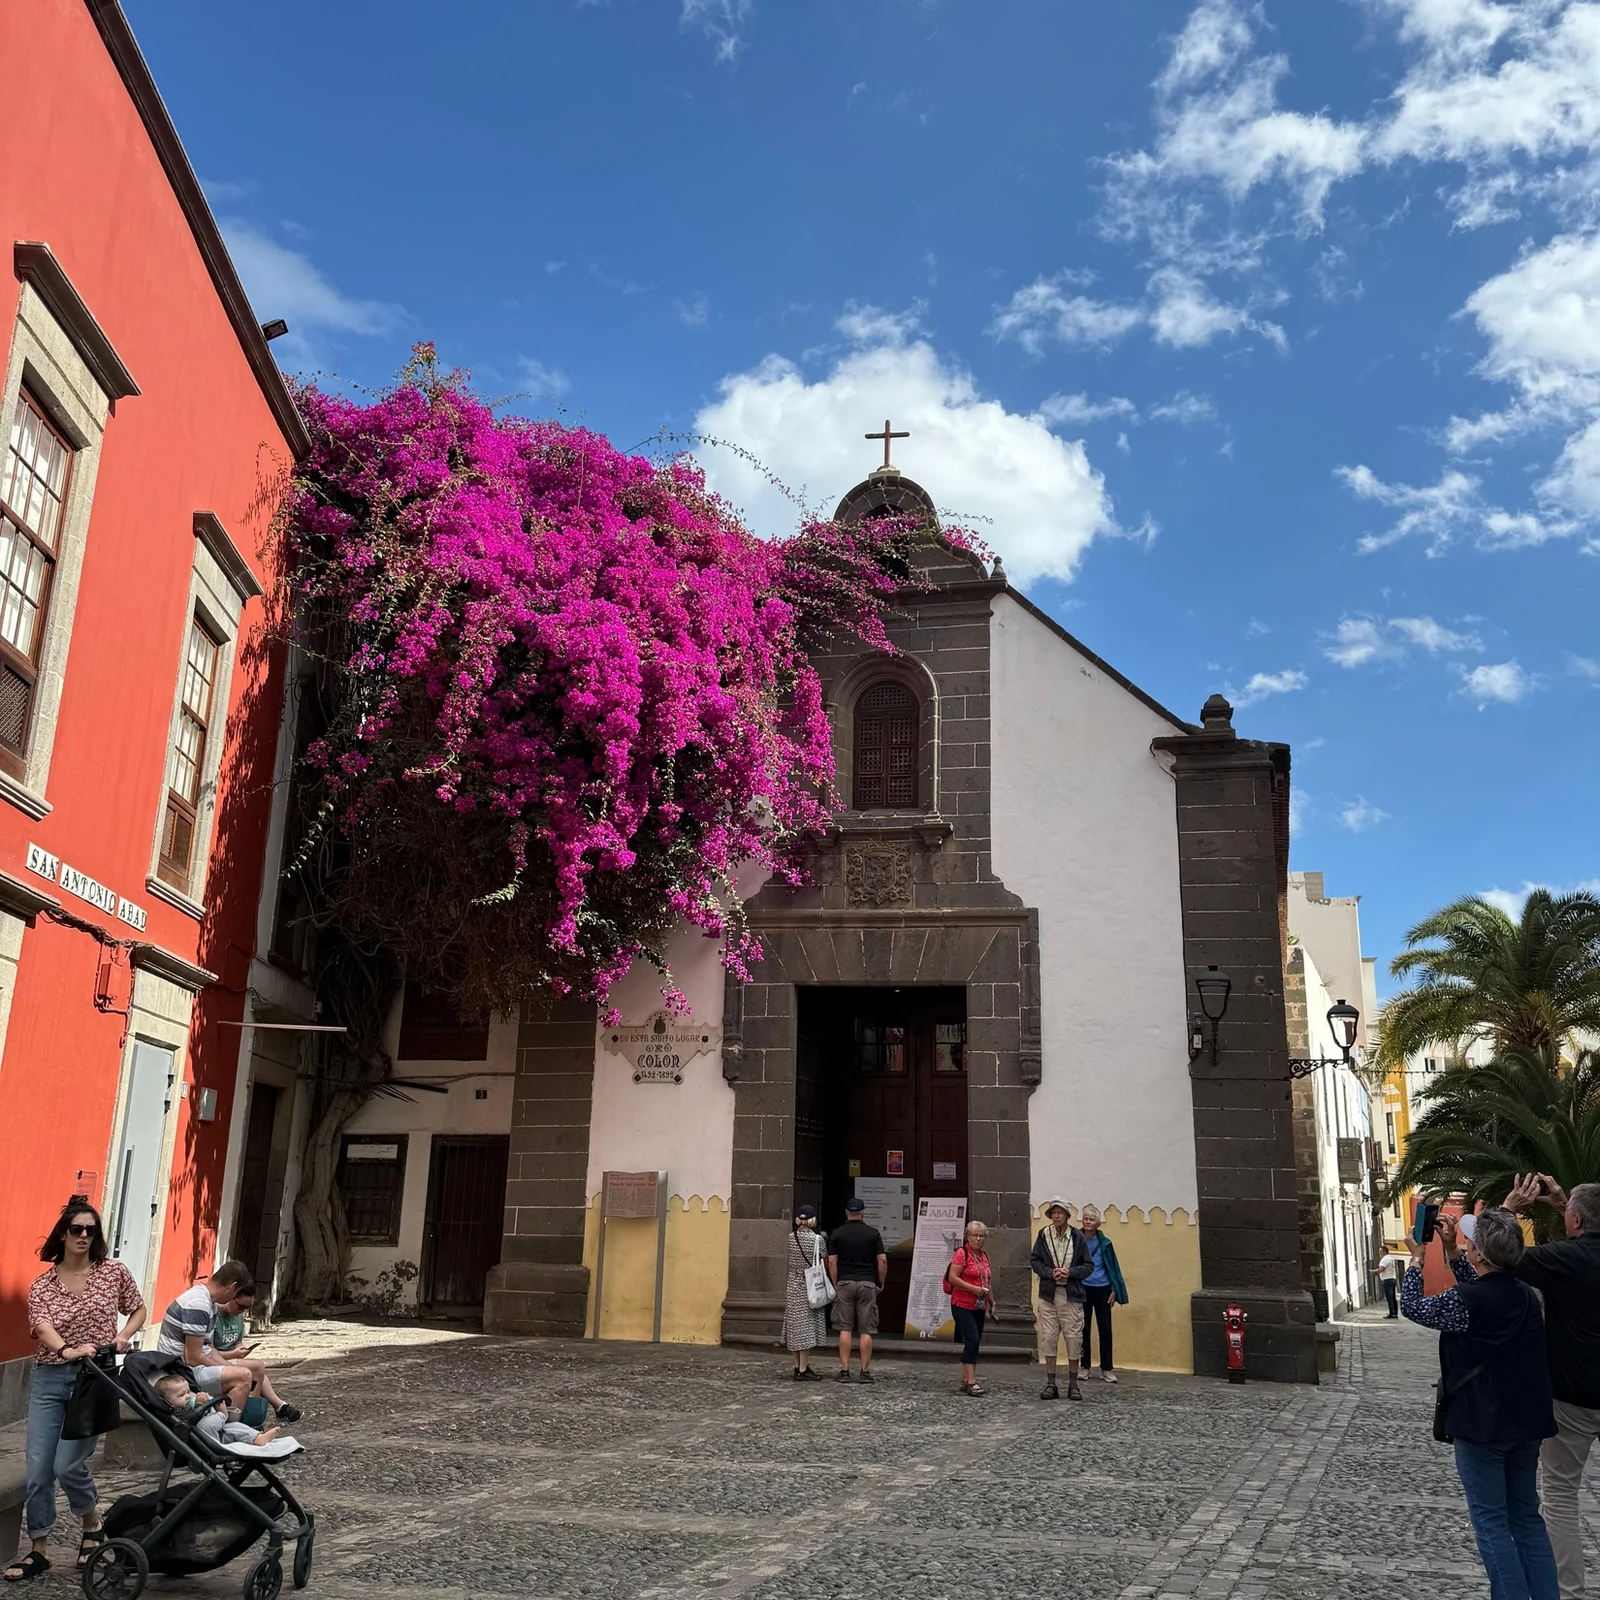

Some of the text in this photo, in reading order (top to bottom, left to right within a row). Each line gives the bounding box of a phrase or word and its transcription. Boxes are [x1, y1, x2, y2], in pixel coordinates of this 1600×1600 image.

[30, 848, 147, 929] SAN ANTONIO ABAD
[620, 1035, 700, 1043] EN ESTE SANTO LUGAR
[637, 1054, 680, 1068] COLON
[929, 1209, 955, 1218] ABAD
